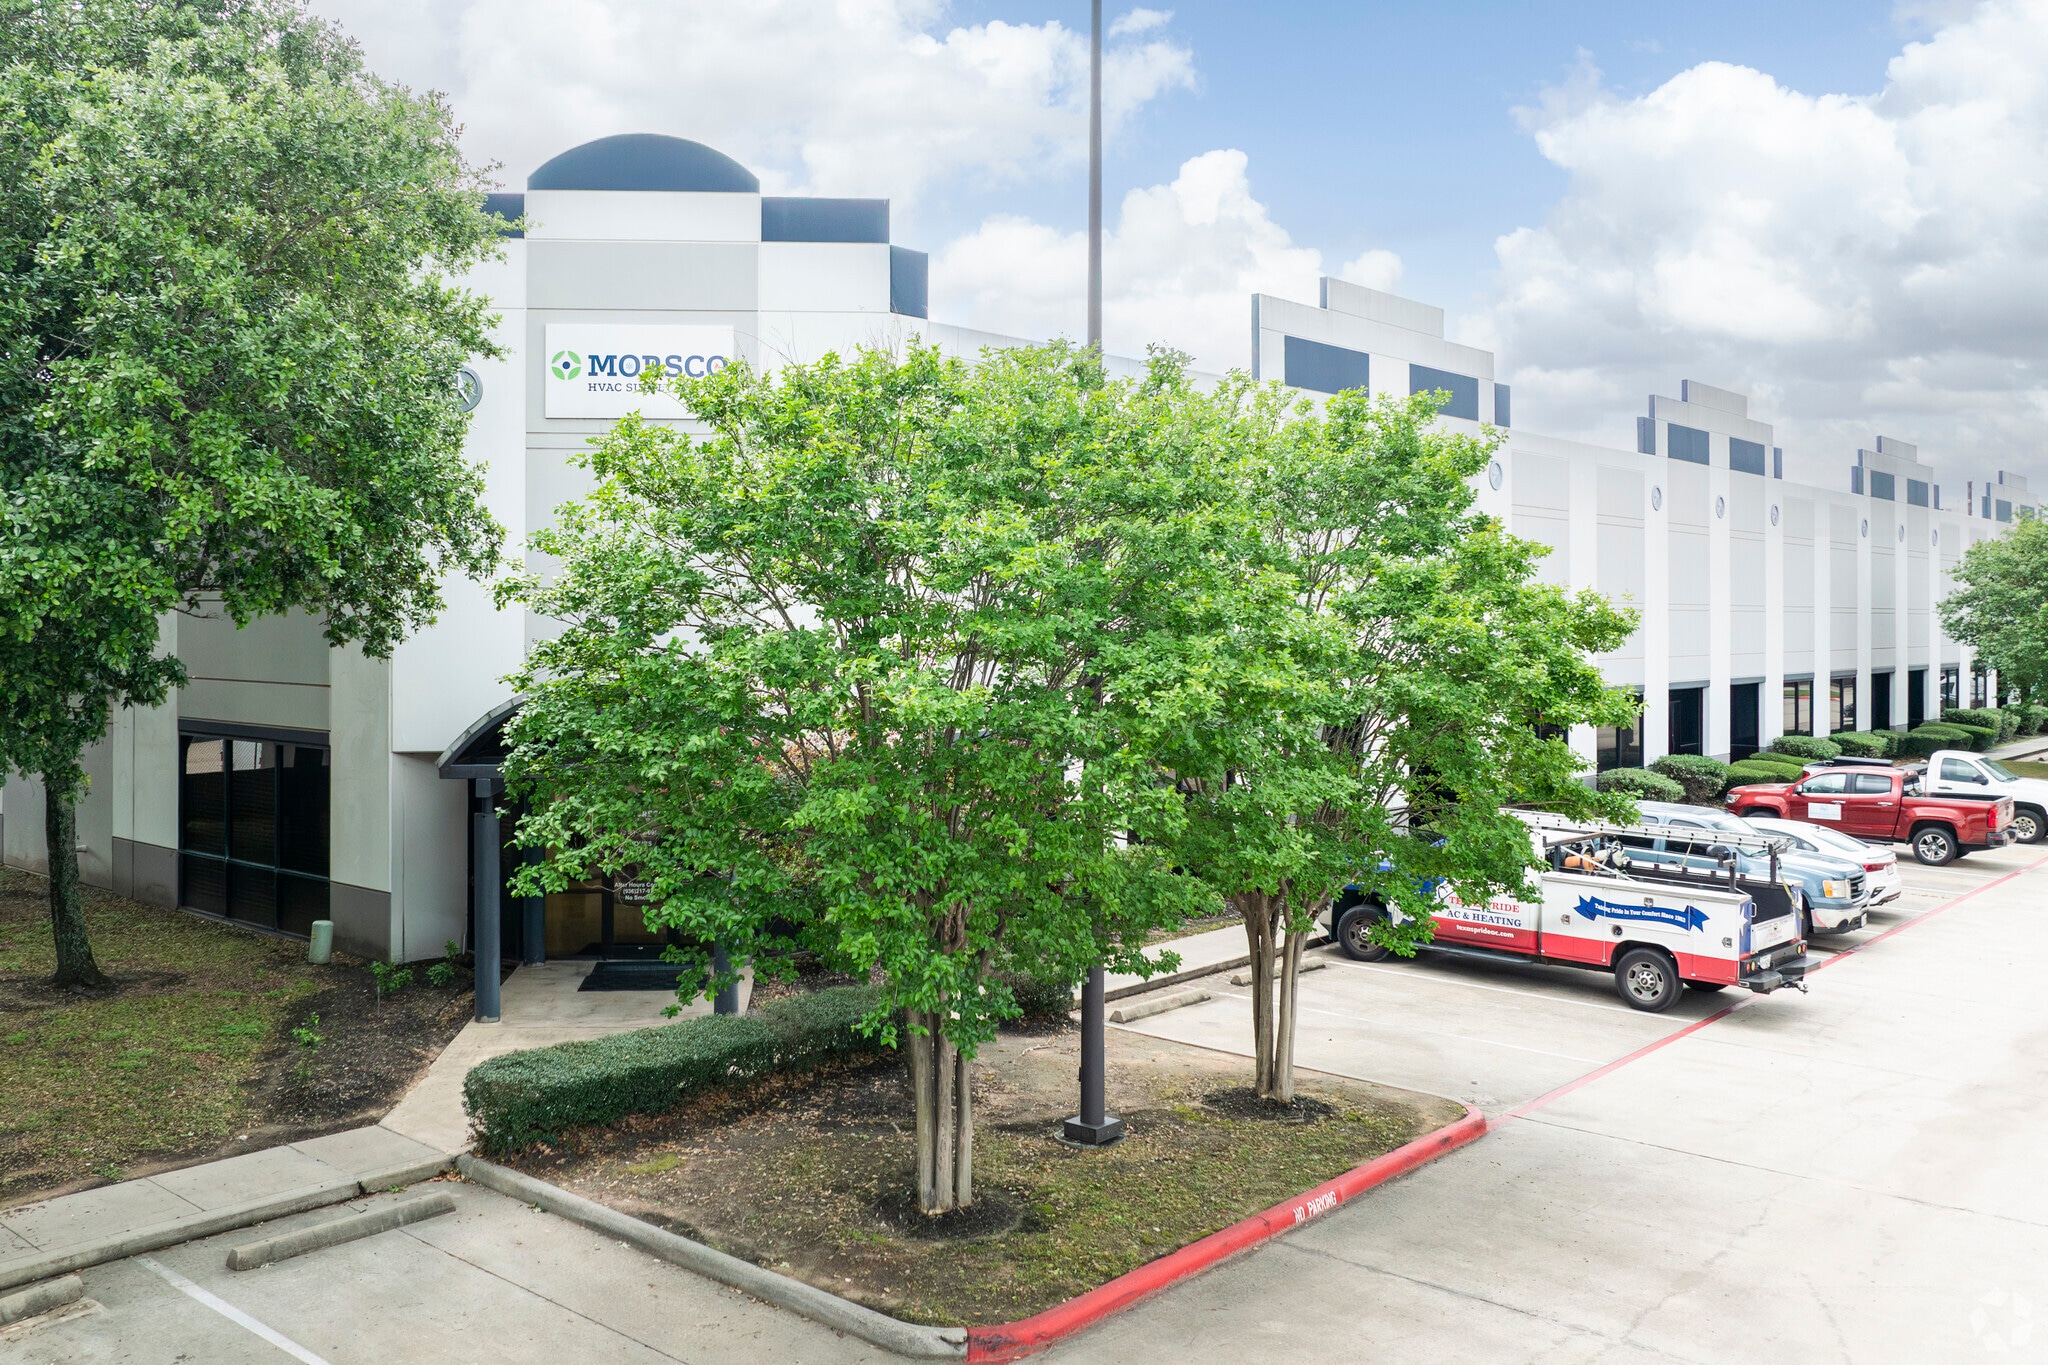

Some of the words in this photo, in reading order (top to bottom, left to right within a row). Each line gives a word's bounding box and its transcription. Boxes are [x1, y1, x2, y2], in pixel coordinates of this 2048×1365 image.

[588, 382, 623, 392] HVAC
[1488, 901, 1520, 913] RIDE
[1447, 910, 1461, 919] AC
[1462, 912, 1470, 920] &
[1472, 913, 1522, 928] HEATING
[1456, 924, 1515, 939] texasprideac.com
[1293, 1206, 1306, 1224] NO
[1306, 1190, 1337, 1217] PARKING
